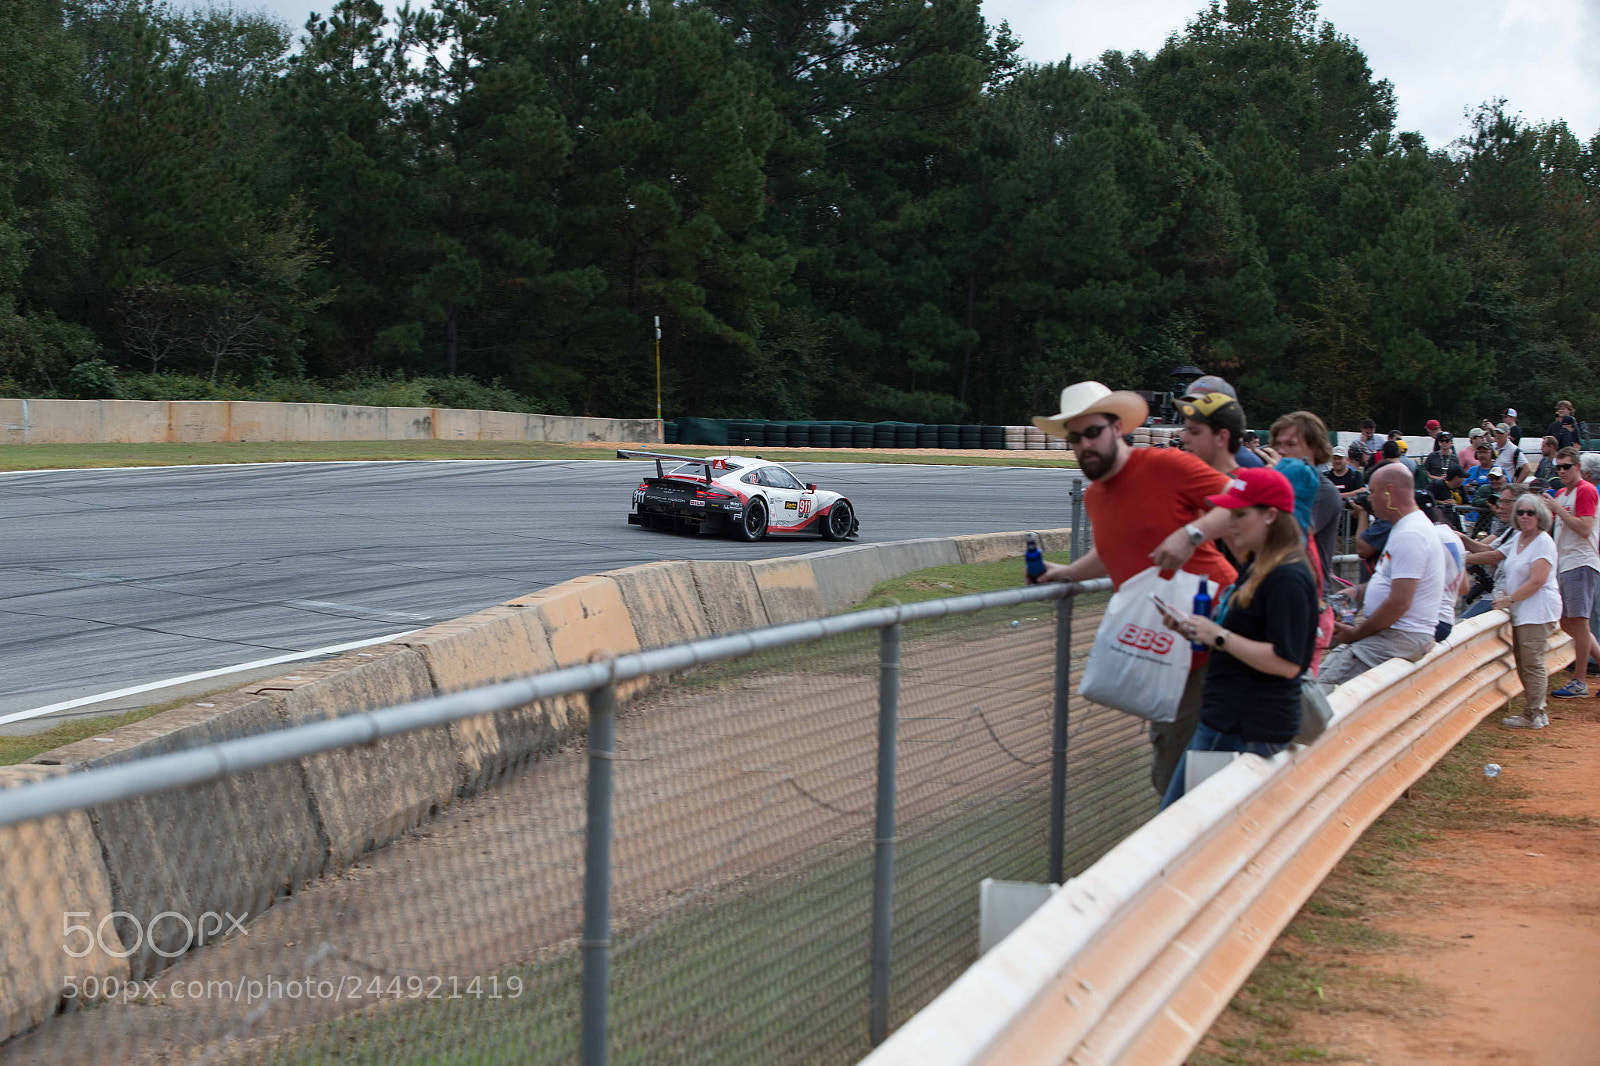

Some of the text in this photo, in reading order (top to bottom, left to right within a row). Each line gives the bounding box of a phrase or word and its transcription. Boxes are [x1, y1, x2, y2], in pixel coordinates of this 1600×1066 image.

[634, 490, 646, 504] 911
[799, 500, 811, 512] 911
[1117, 623, 1174, 655] BBS
